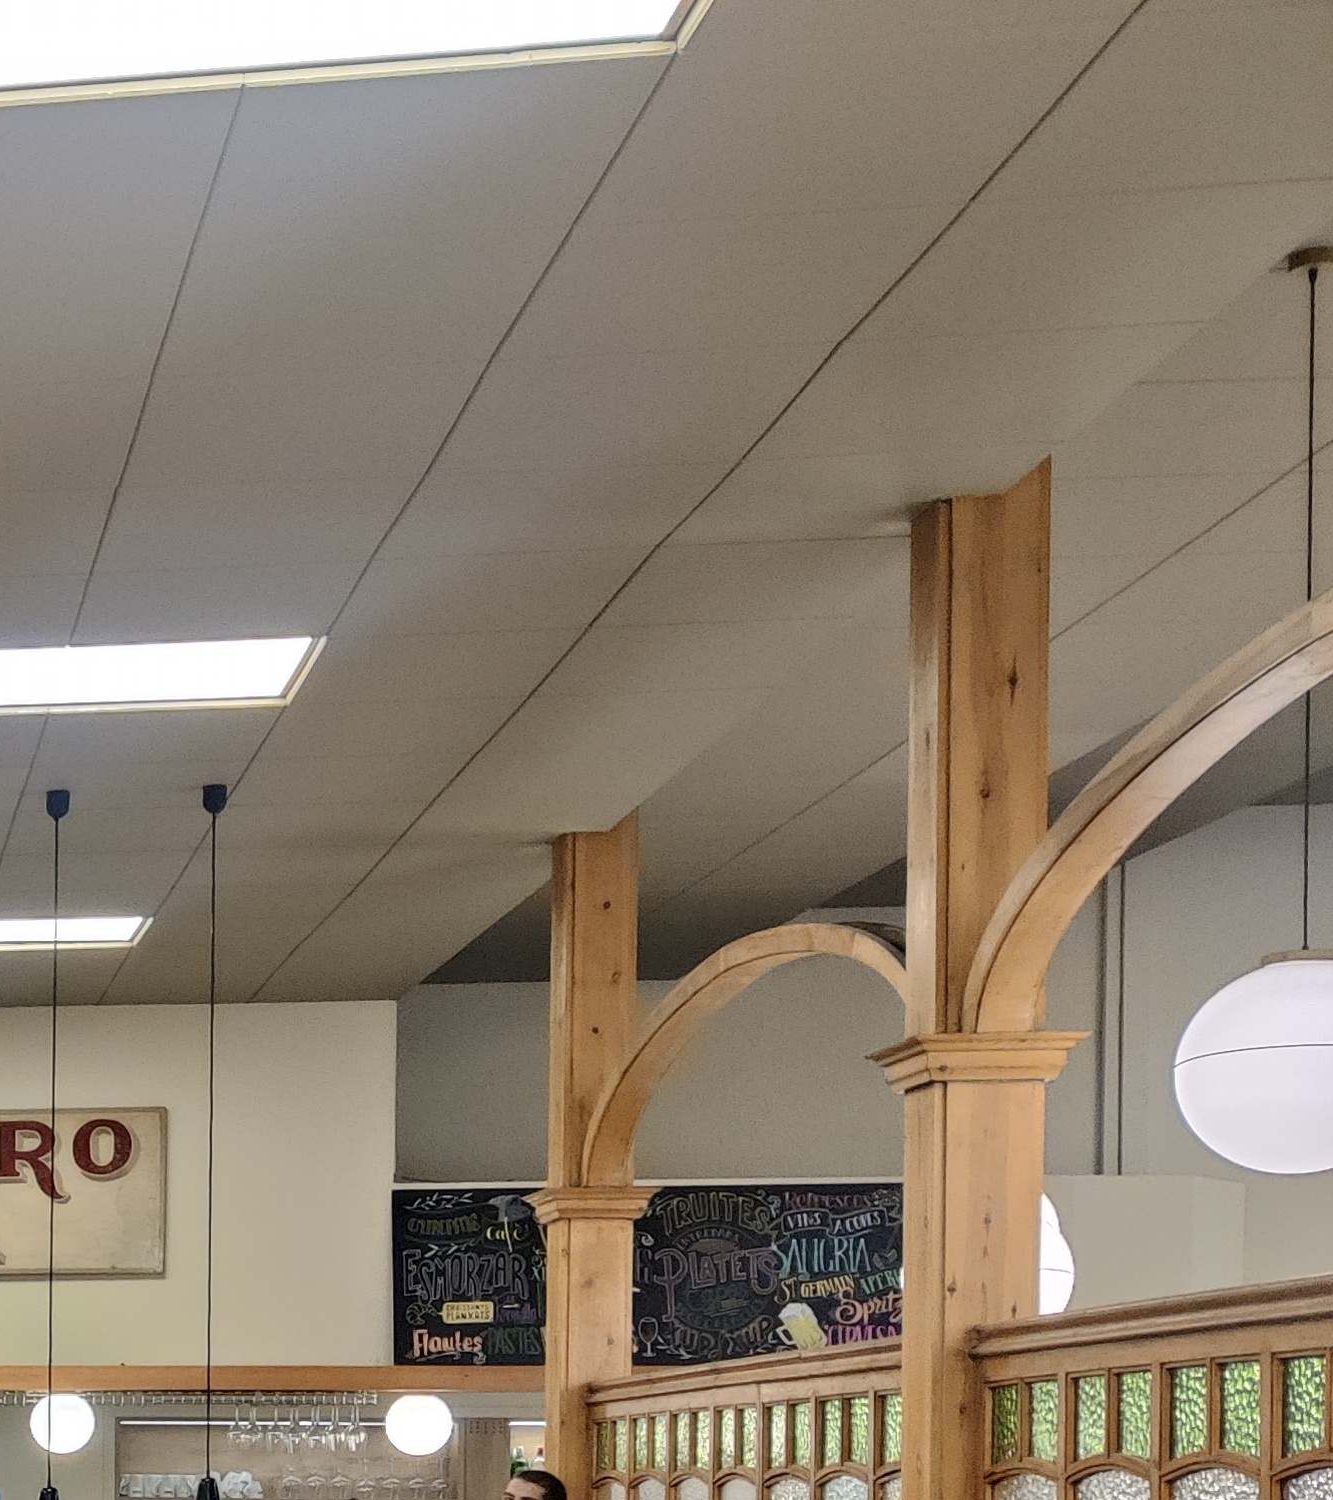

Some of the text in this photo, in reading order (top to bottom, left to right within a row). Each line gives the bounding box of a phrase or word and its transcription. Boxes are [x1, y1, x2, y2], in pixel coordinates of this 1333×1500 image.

[656, 1191, 772, 1236] TRUITES
[787, 1212, 822, 1230] VINS
[402, 1248, 530, 1302] ESMORZAR
[654, 1247, 779, 1322] PLATETS
[412, 1328, 484, 1359] Flautes
